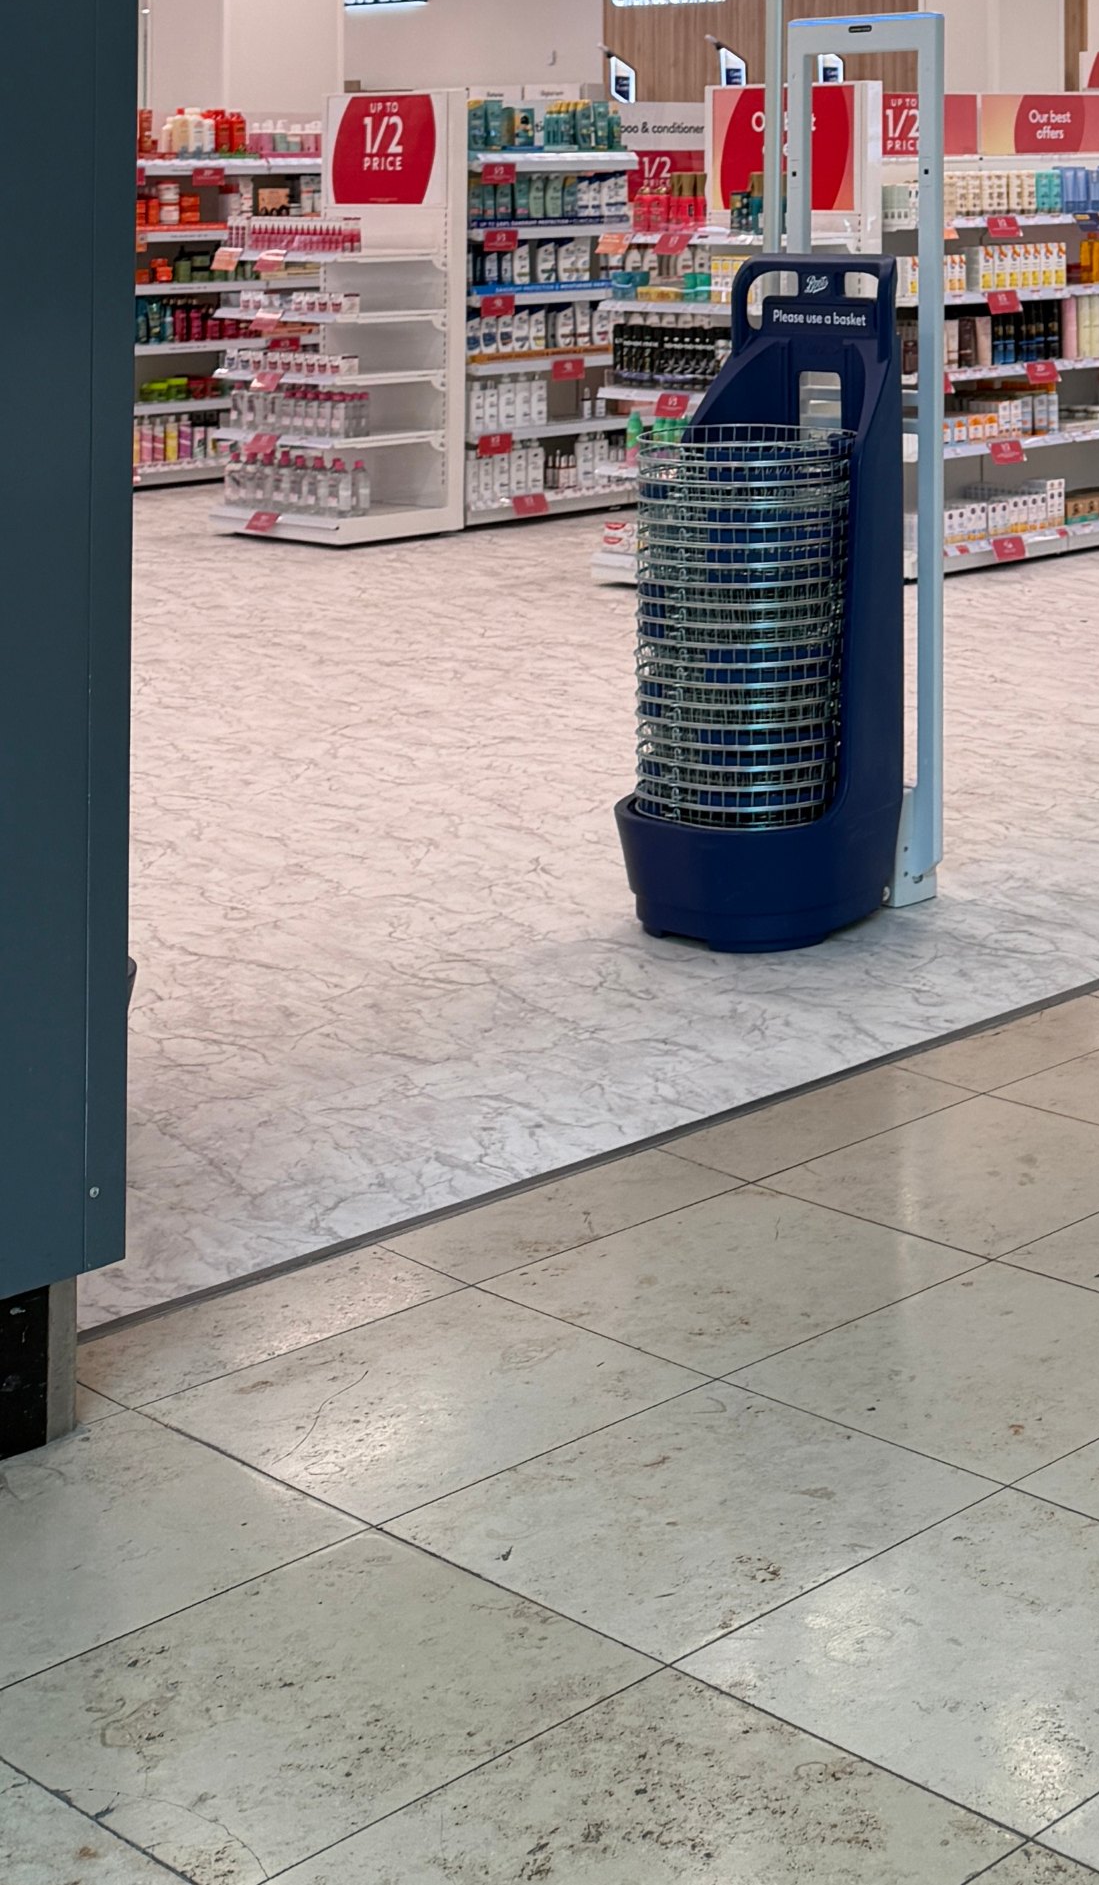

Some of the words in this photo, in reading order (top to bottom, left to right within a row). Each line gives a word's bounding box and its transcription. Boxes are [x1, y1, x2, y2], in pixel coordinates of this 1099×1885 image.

[369, 102, 384, 114] UP
[384, 101, 399, 113] TO
[890, 99, 902, 107] UP
[905, 98, 918, 107] TO
[885, 109, 919, 138] 1/2
[1028, 109, 1050, 124] Our
[1050, 108, 1072, 123] best
[652, 121, 705, 134] conditioner
[1036, 126, 1065, 140] offers
[363, 116, 404, 155] 1/2
[886, 140, 919, 151] PRIC
[363, 157, 403, 171] PRICE
[643, 156, 671, 179] 1/2
[803, 275, 829, 294] Boots
[772, 309, 804, 323] Please
[806, 315, 824, 324] use
[824, 315, 832, 324] a
[833, 311, 867, 326] basket
